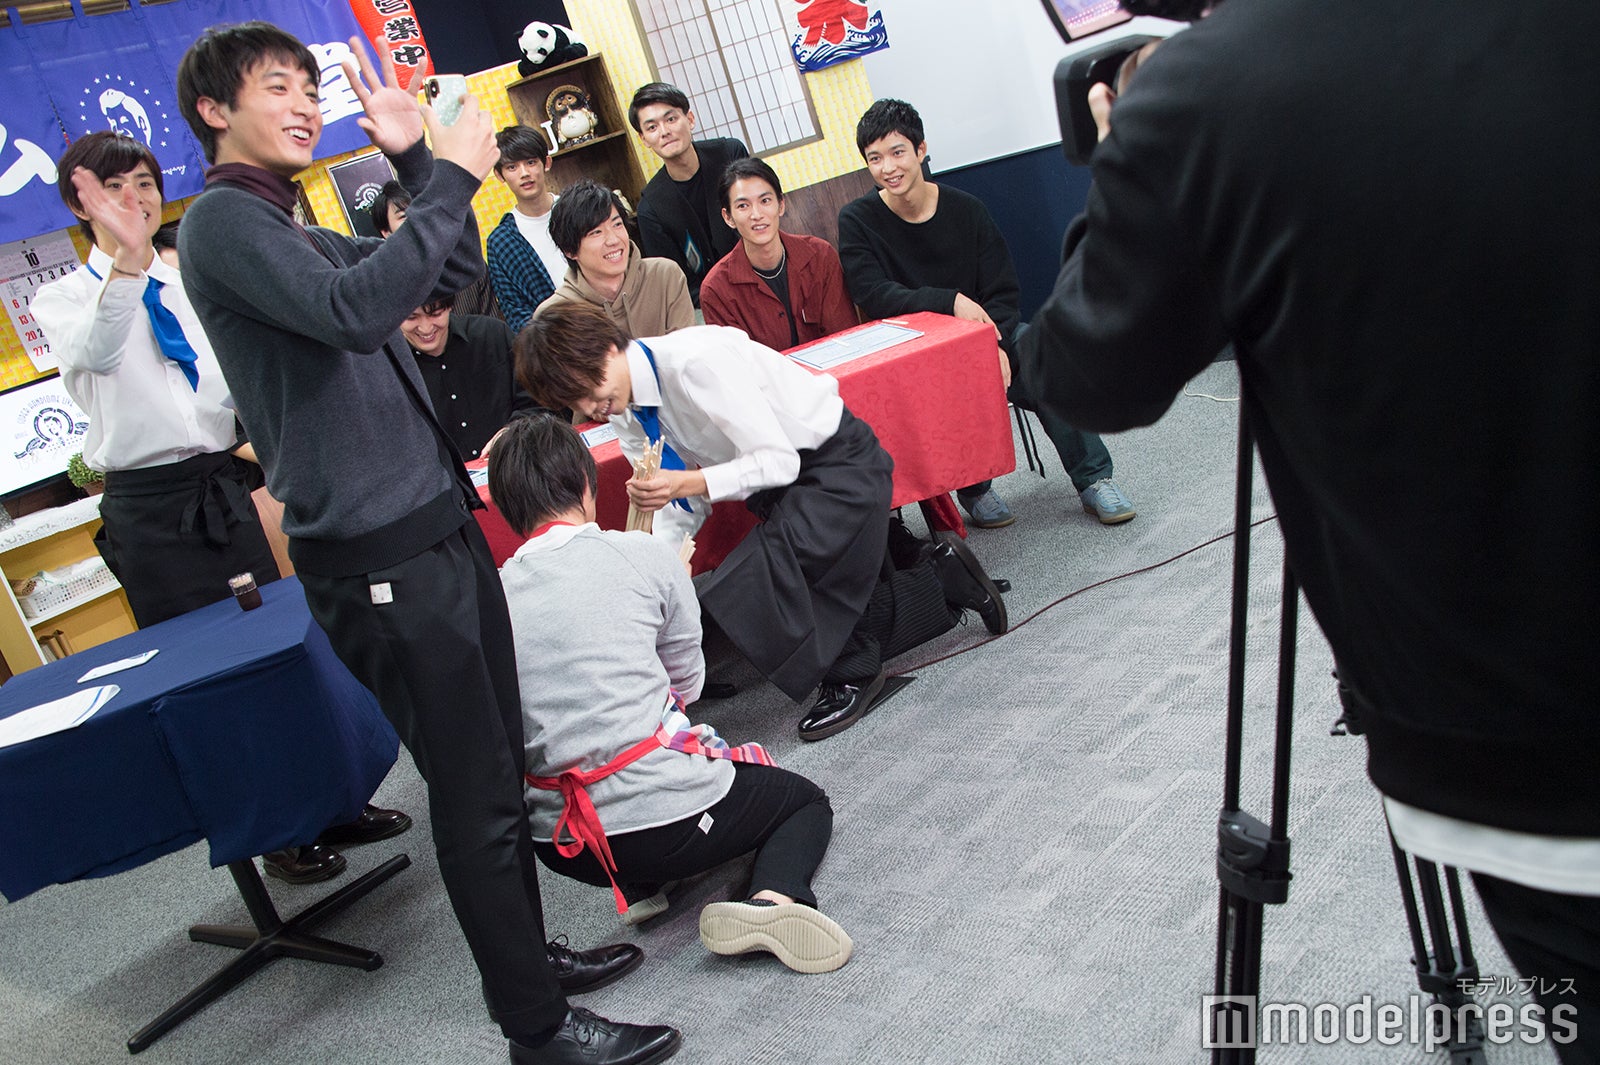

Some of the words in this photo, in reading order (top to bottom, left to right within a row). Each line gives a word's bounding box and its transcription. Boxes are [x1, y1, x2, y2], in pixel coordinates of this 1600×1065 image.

[25, 252, 40, 267] 10
[27, 277, 33, 286] 1
[37, 274, 45, 283] 2
[48, 271, 56, 280] 3
[60, 267, 67, 276] 4
[70, 264, 77, 272] 5
[12, 299, 20, 309] 6
[23, 296, 29, 306] 7
[18, 314, 29, 325] 13
[25, 330, 38, 341] 20
[33, 345, 44, 356] 27
